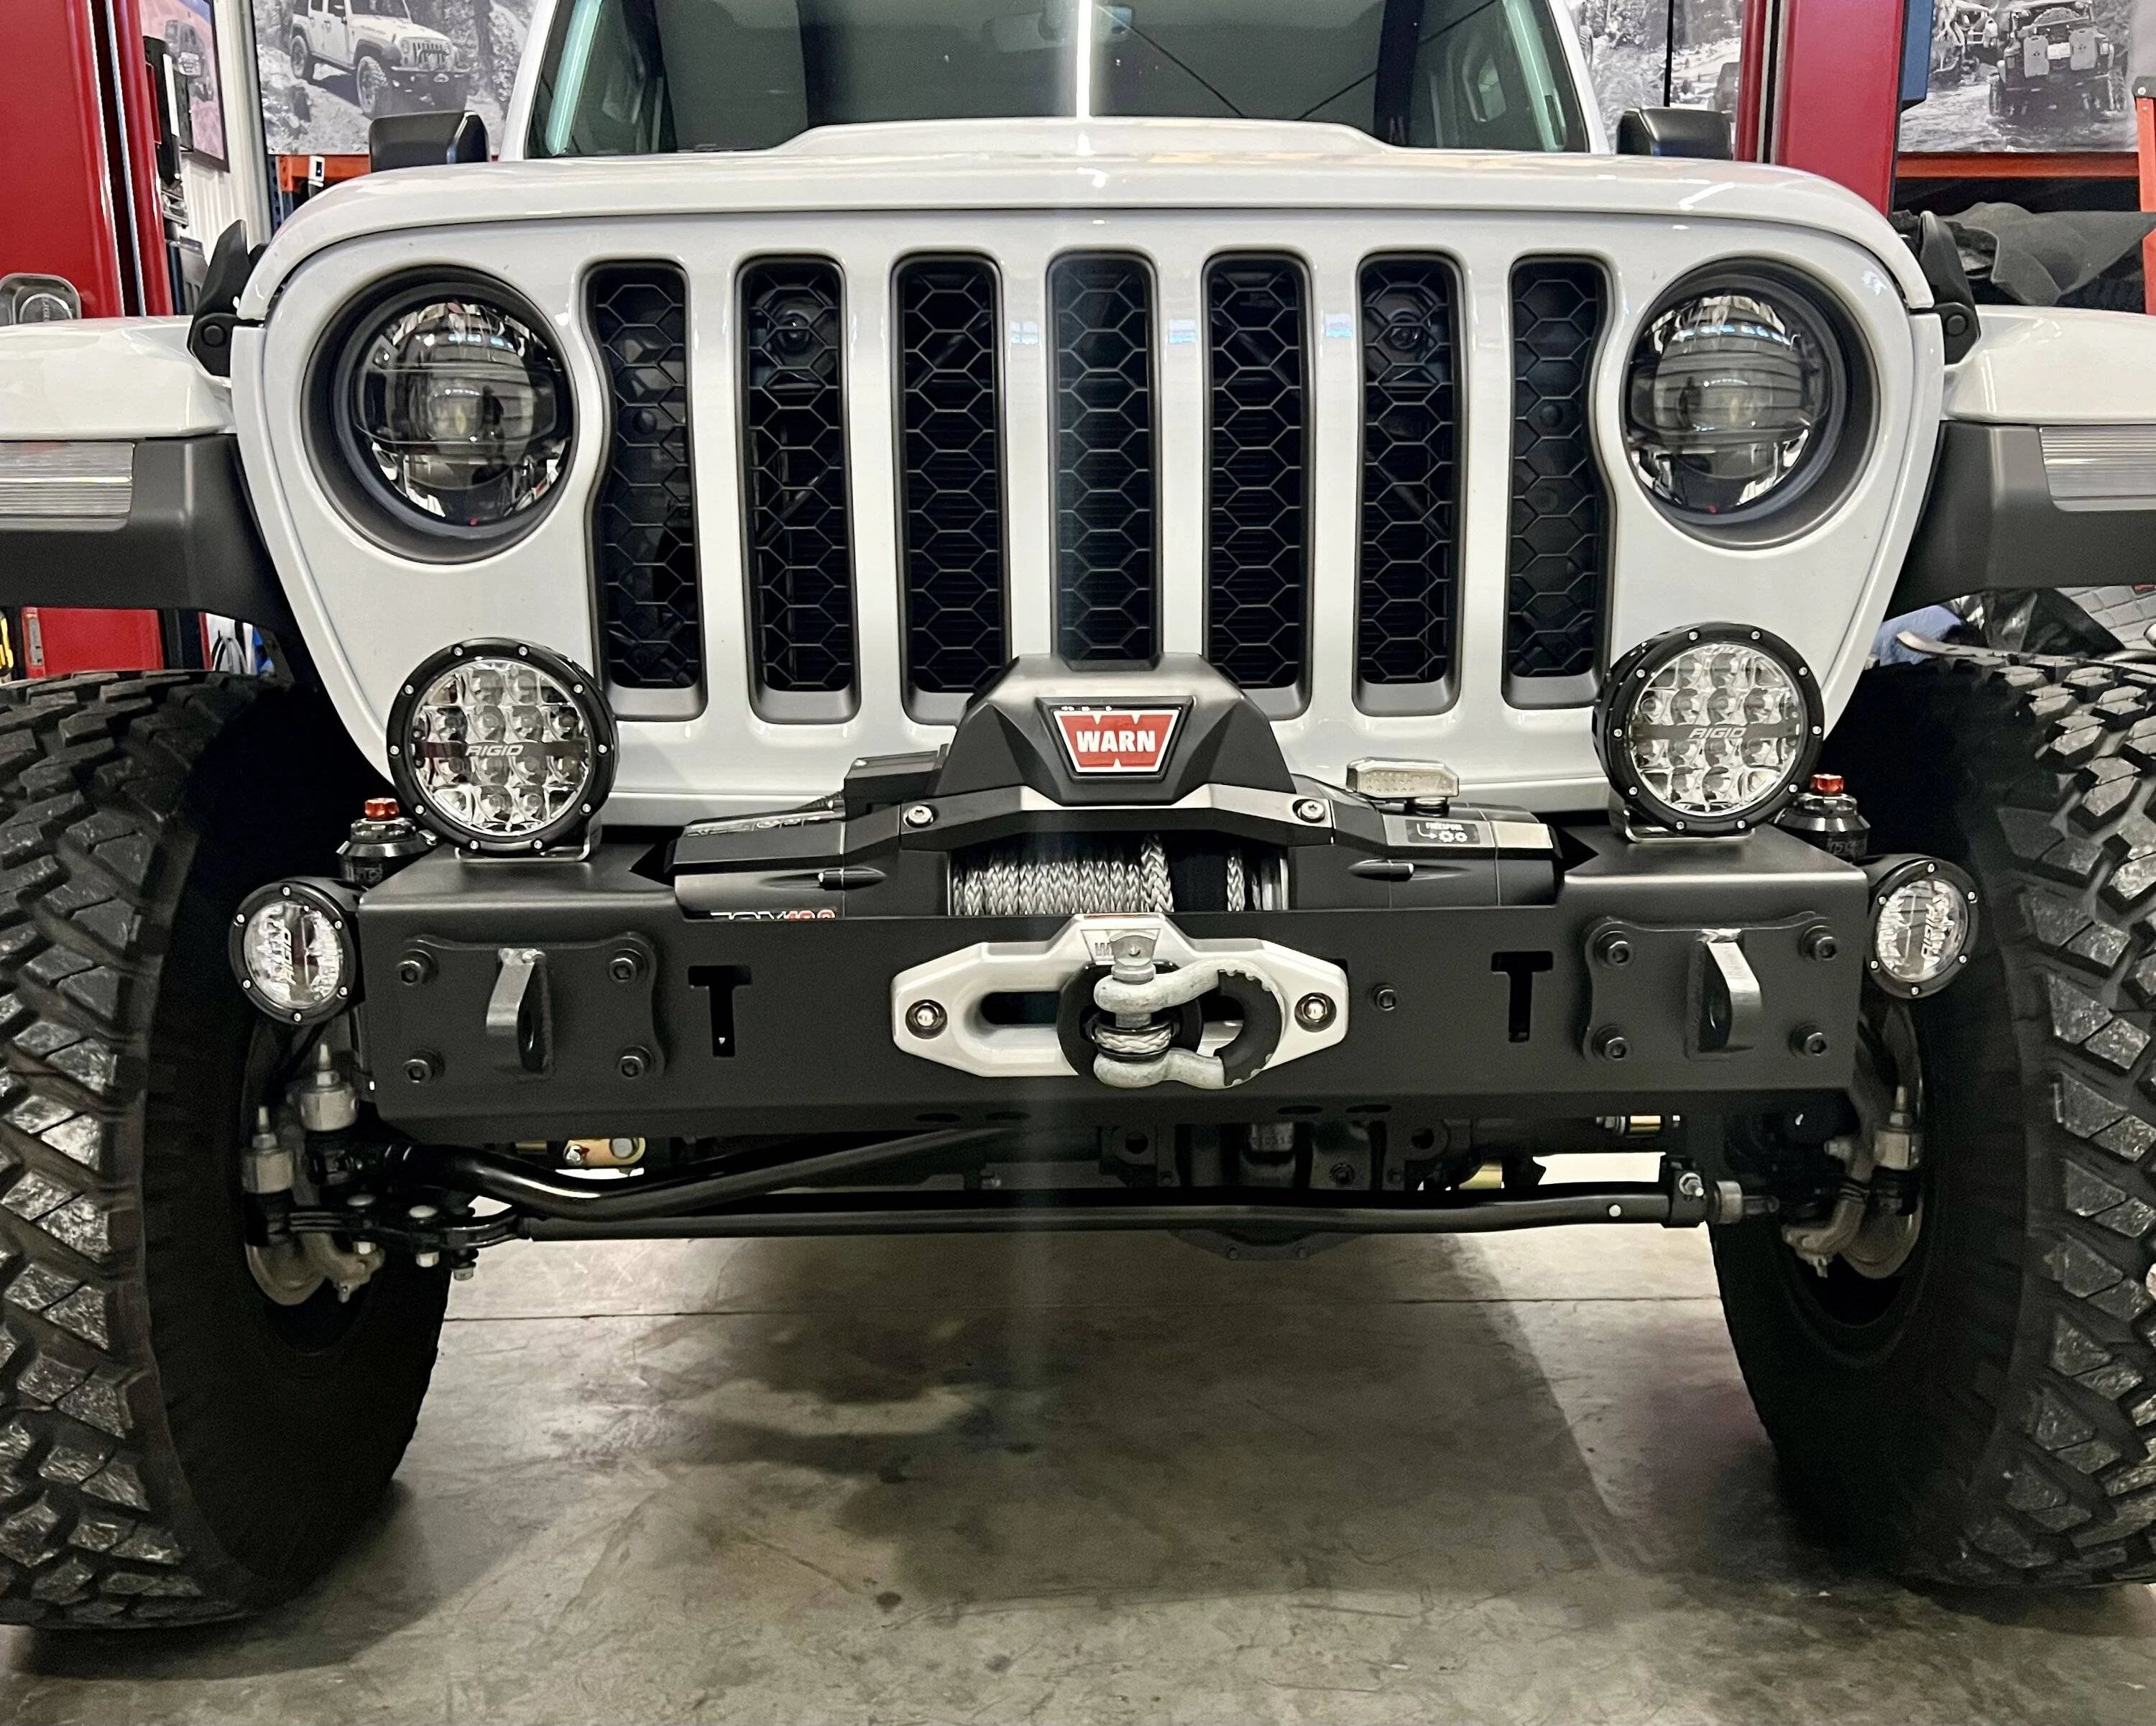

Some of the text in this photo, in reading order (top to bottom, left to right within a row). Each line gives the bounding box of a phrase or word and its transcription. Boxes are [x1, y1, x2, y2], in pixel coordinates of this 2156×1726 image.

[1076, 730, 1156, 752] WARN
[1688, 727, 1746, 739] RIGID
[465, 745, 524, 756] RIGID
[282, 927, 296, 986] RIGID
